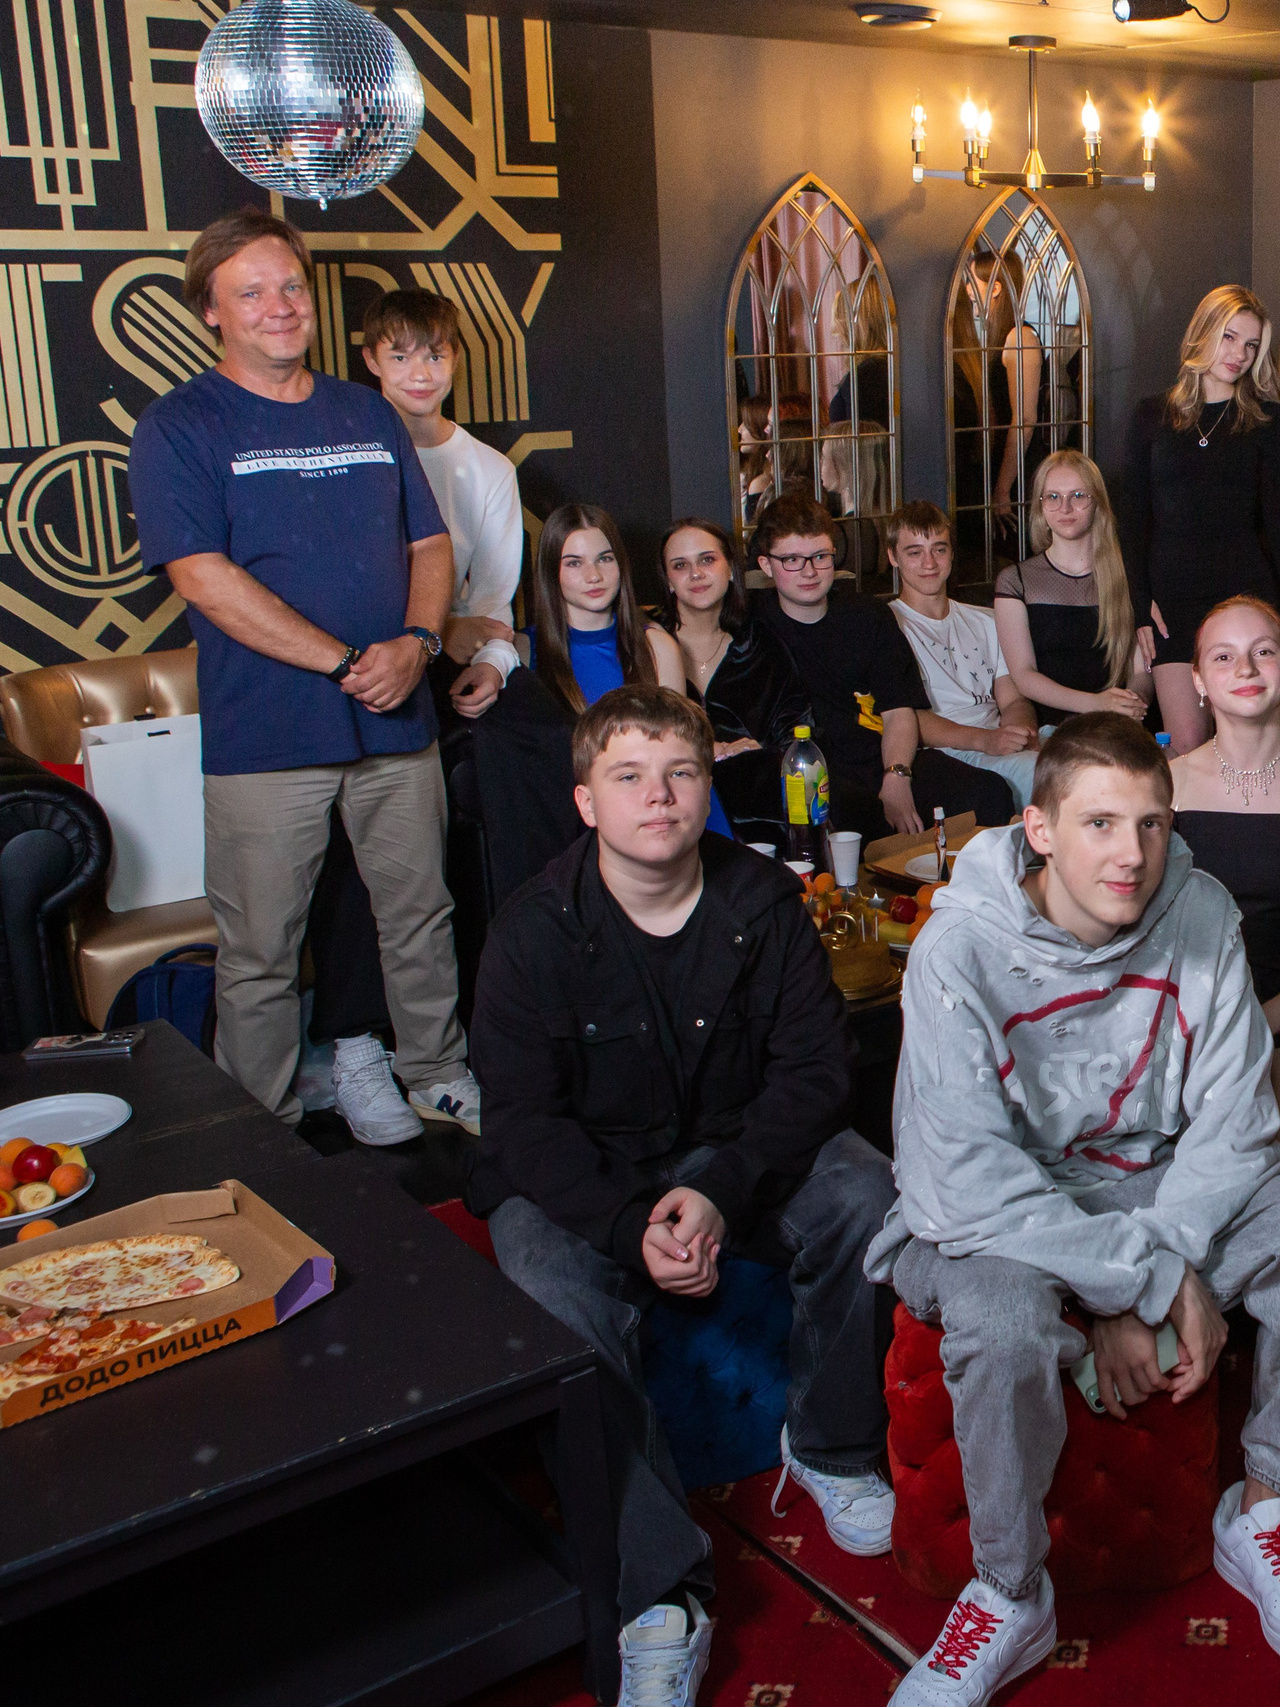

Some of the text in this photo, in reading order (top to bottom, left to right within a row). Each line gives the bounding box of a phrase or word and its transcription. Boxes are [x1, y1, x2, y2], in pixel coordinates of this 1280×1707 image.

[235, 442, 384, 462] UNITED STATES POLO ASSOCIATION
[246, 452, 386, 471] LIVE AUTHENTICALLY
[299, 467, 349, 479] SINCE 1890
[40, 1317, 242, 1408] ДОДО ПИЦЦА
